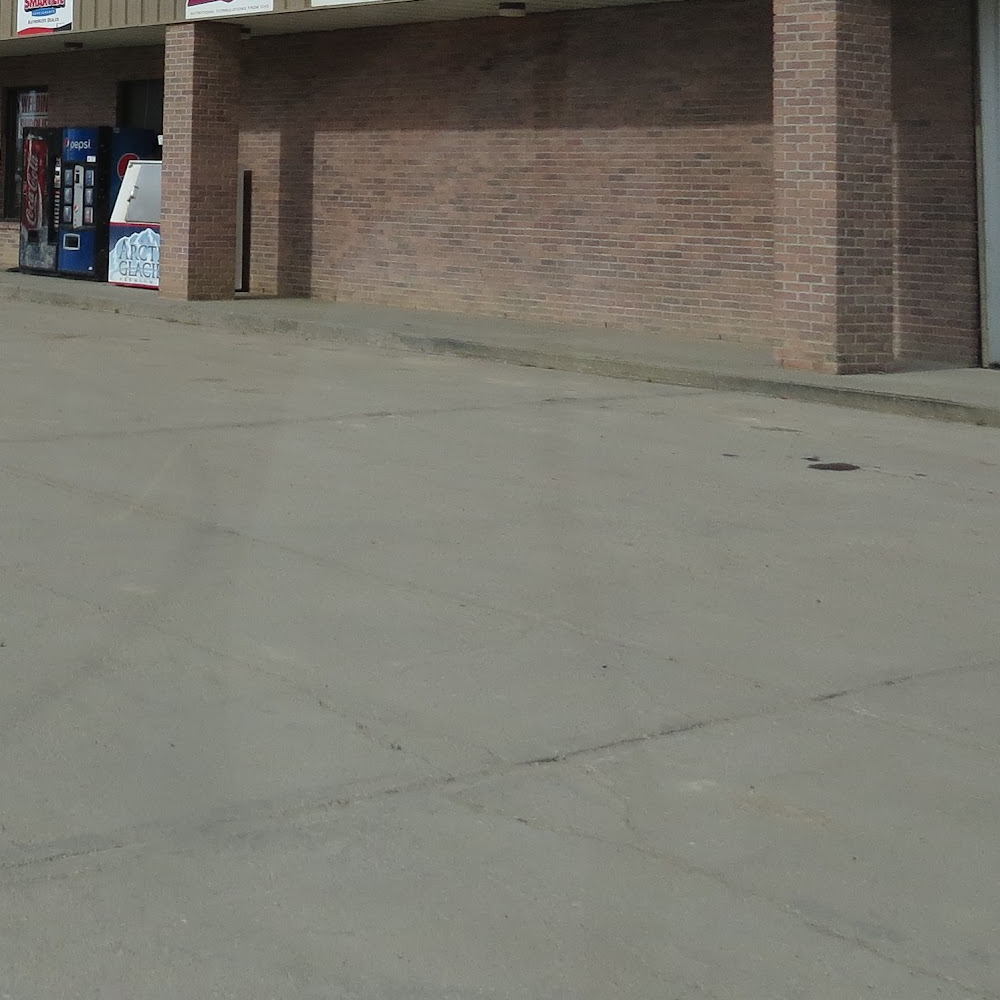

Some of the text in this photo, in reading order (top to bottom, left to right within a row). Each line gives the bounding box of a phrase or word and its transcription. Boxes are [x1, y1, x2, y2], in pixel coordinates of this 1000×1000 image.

[69, 138, 91, 151] pepsi
[119, 239, 160, 262] ARCTI
[119, 260, 160, 279] GLACI
